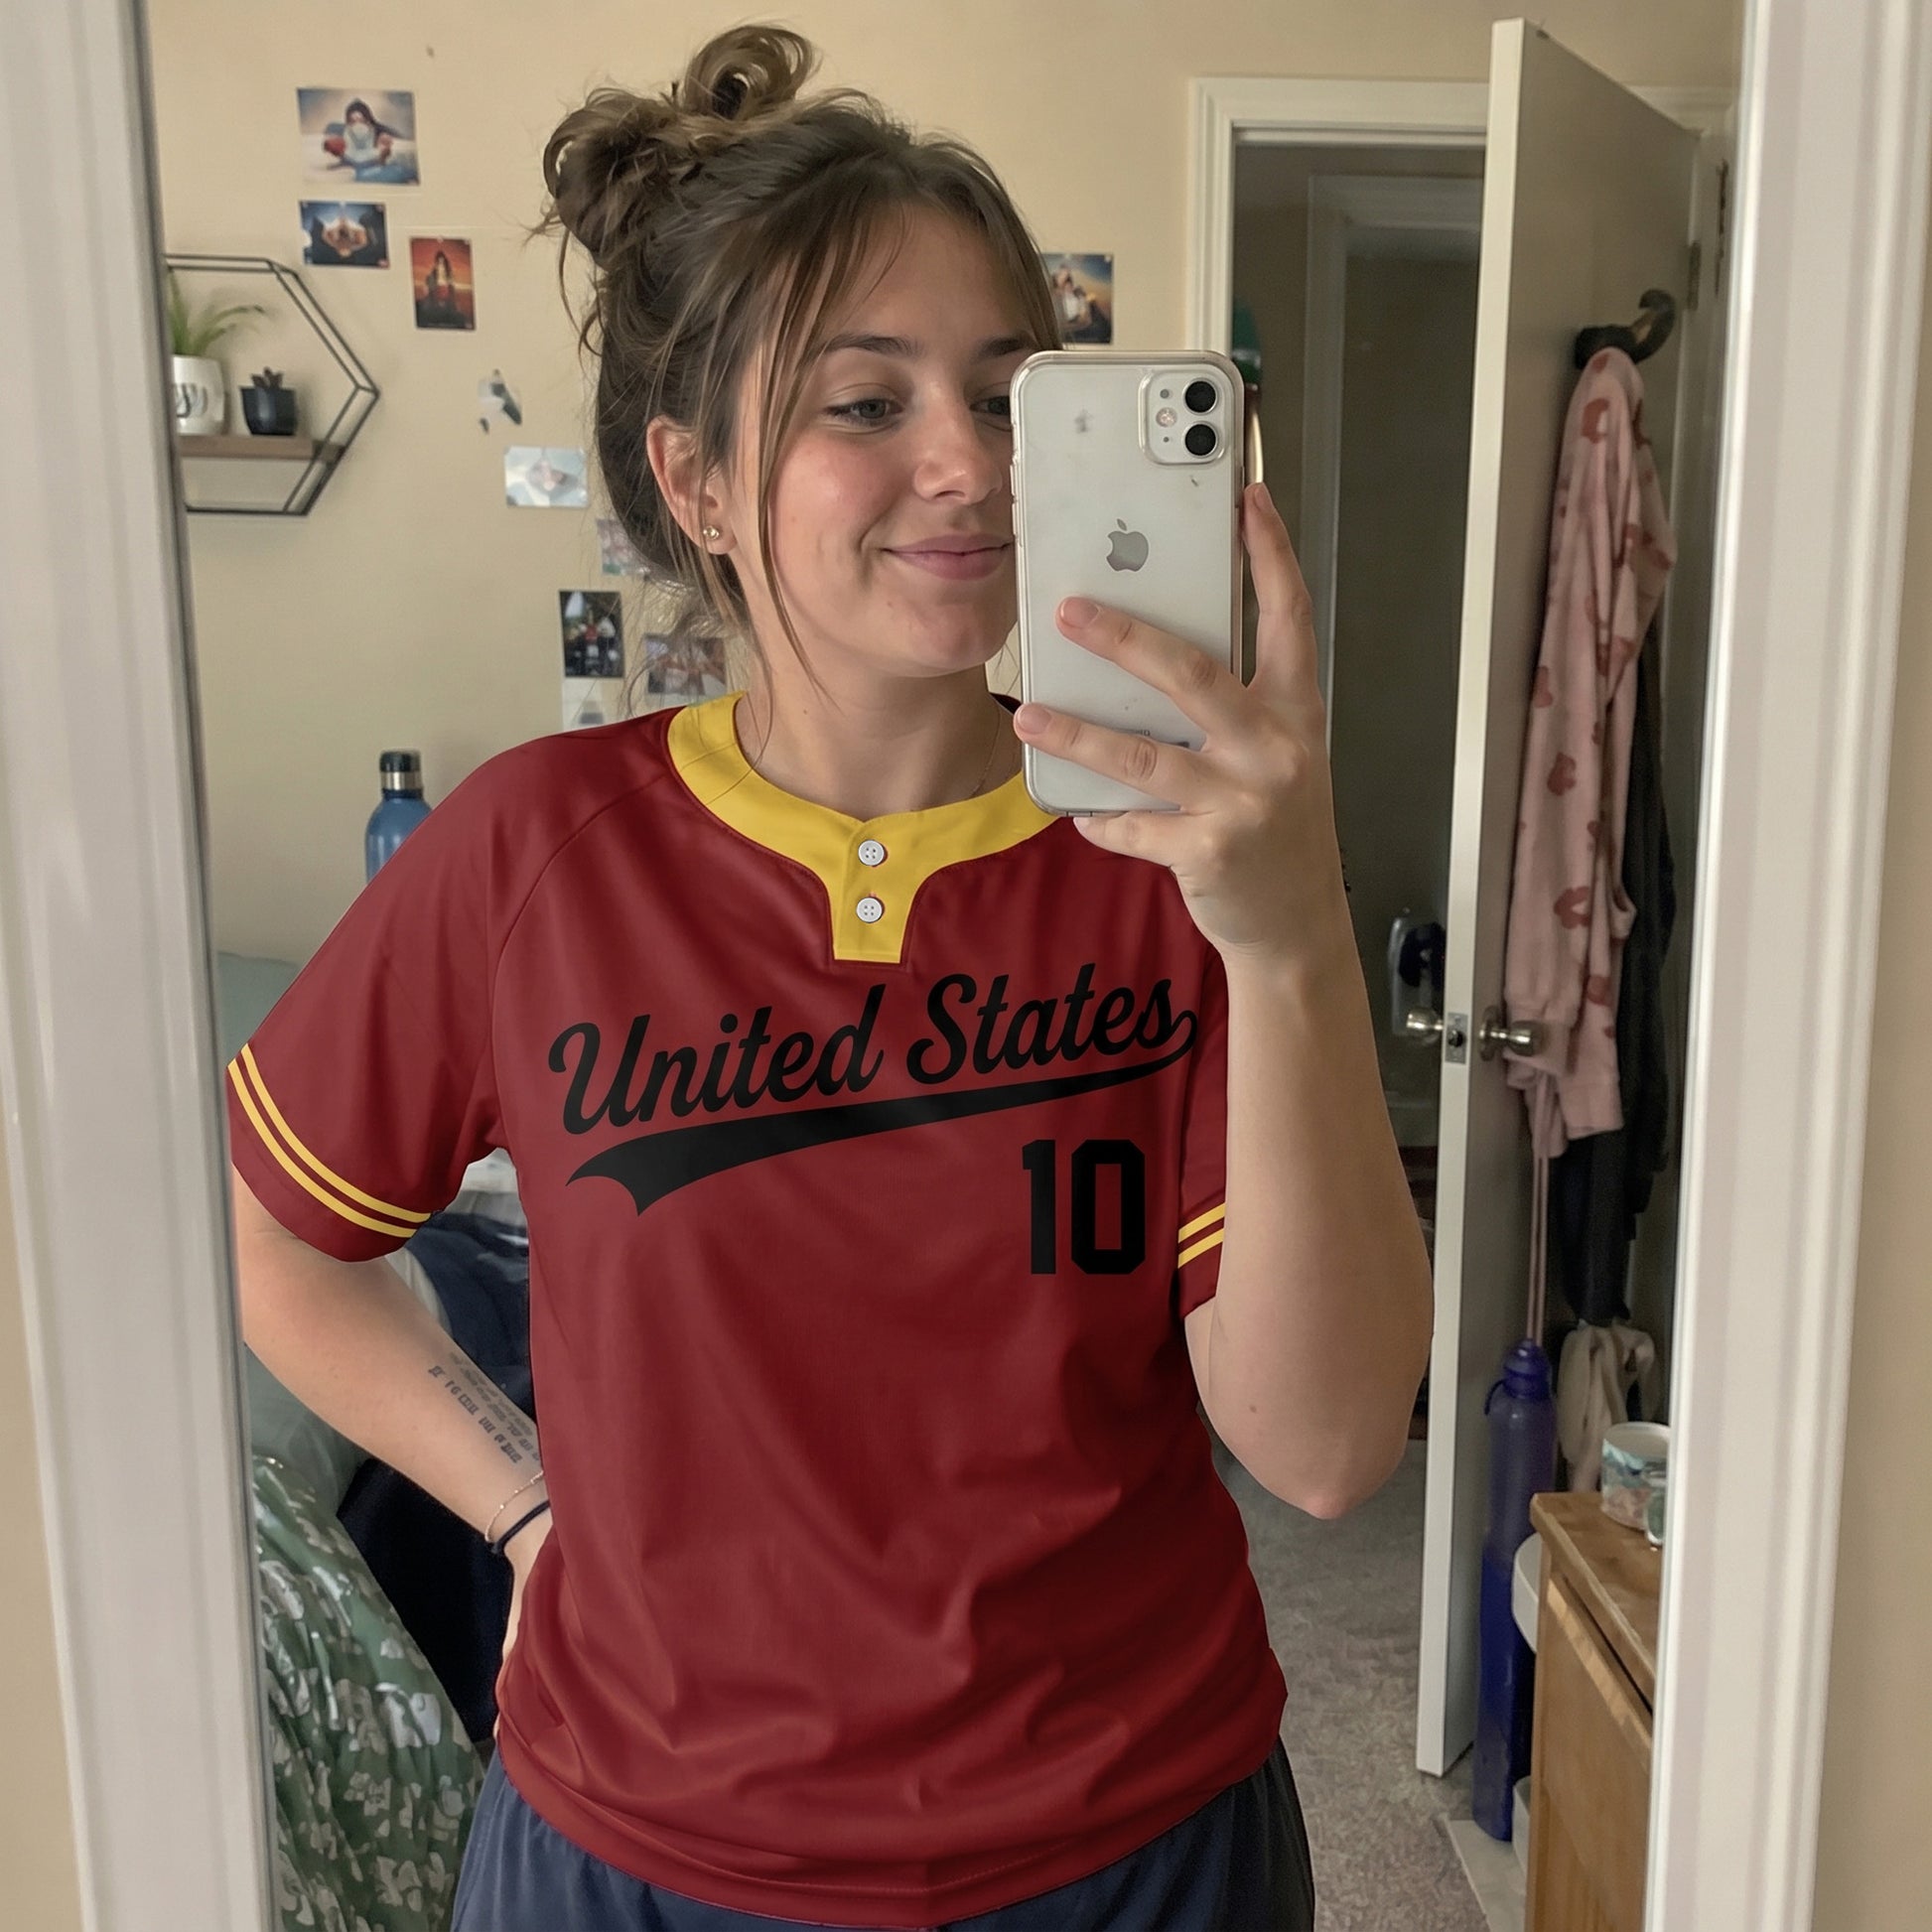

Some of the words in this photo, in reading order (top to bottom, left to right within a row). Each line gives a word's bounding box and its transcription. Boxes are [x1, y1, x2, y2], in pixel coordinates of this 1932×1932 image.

[548, 983, 887, 1135] United
[905, 962, 1197, 1085] States
[1022, 1139, 1146, 1276] 10
